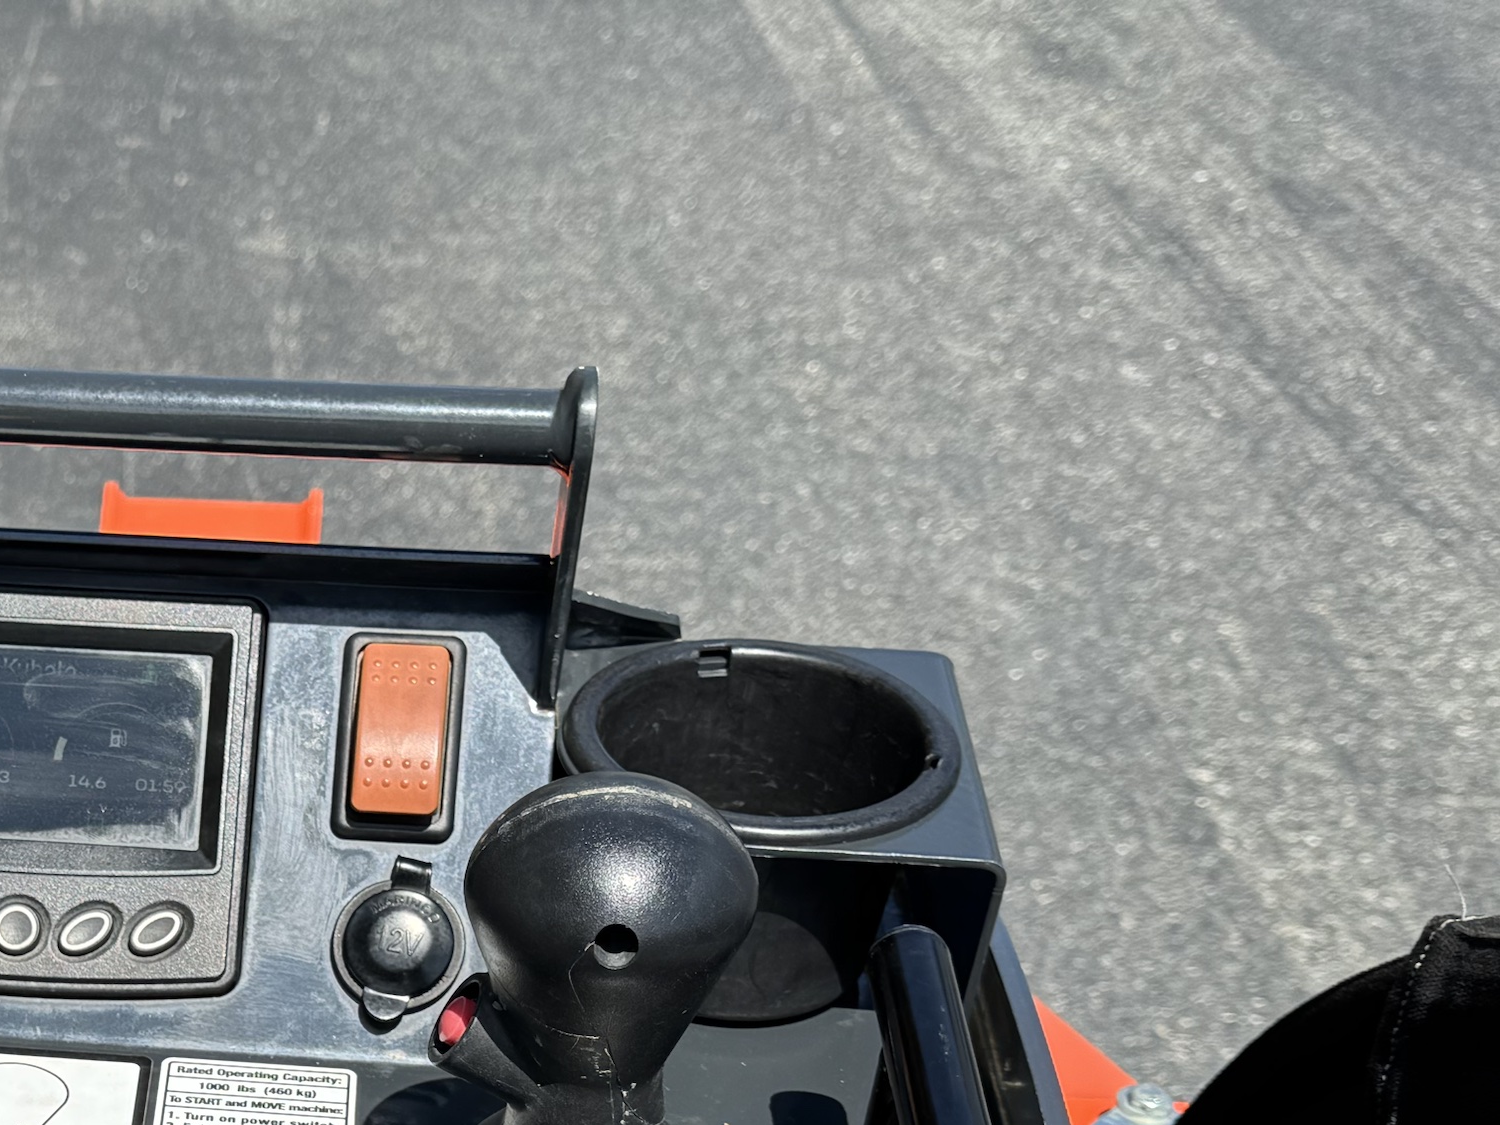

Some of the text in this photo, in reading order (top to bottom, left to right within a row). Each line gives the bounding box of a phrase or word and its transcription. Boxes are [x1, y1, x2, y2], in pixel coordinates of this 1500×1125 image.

[68, 774, 107, 789] 14.6
[377, 925, 424, 957] 12V
[177, 1066, 342, 1085] Rated Operating Capacity:
[199, 1082, 317, 1099] 1000 lbs (460 kg)
[169, 1095, 344, 1115] To START and MOVE machine:
[168, 1111, 180, 1120] 1.
[184, 1111, 214, 1121] Turn
[240, 1117, 285, 1125] power
